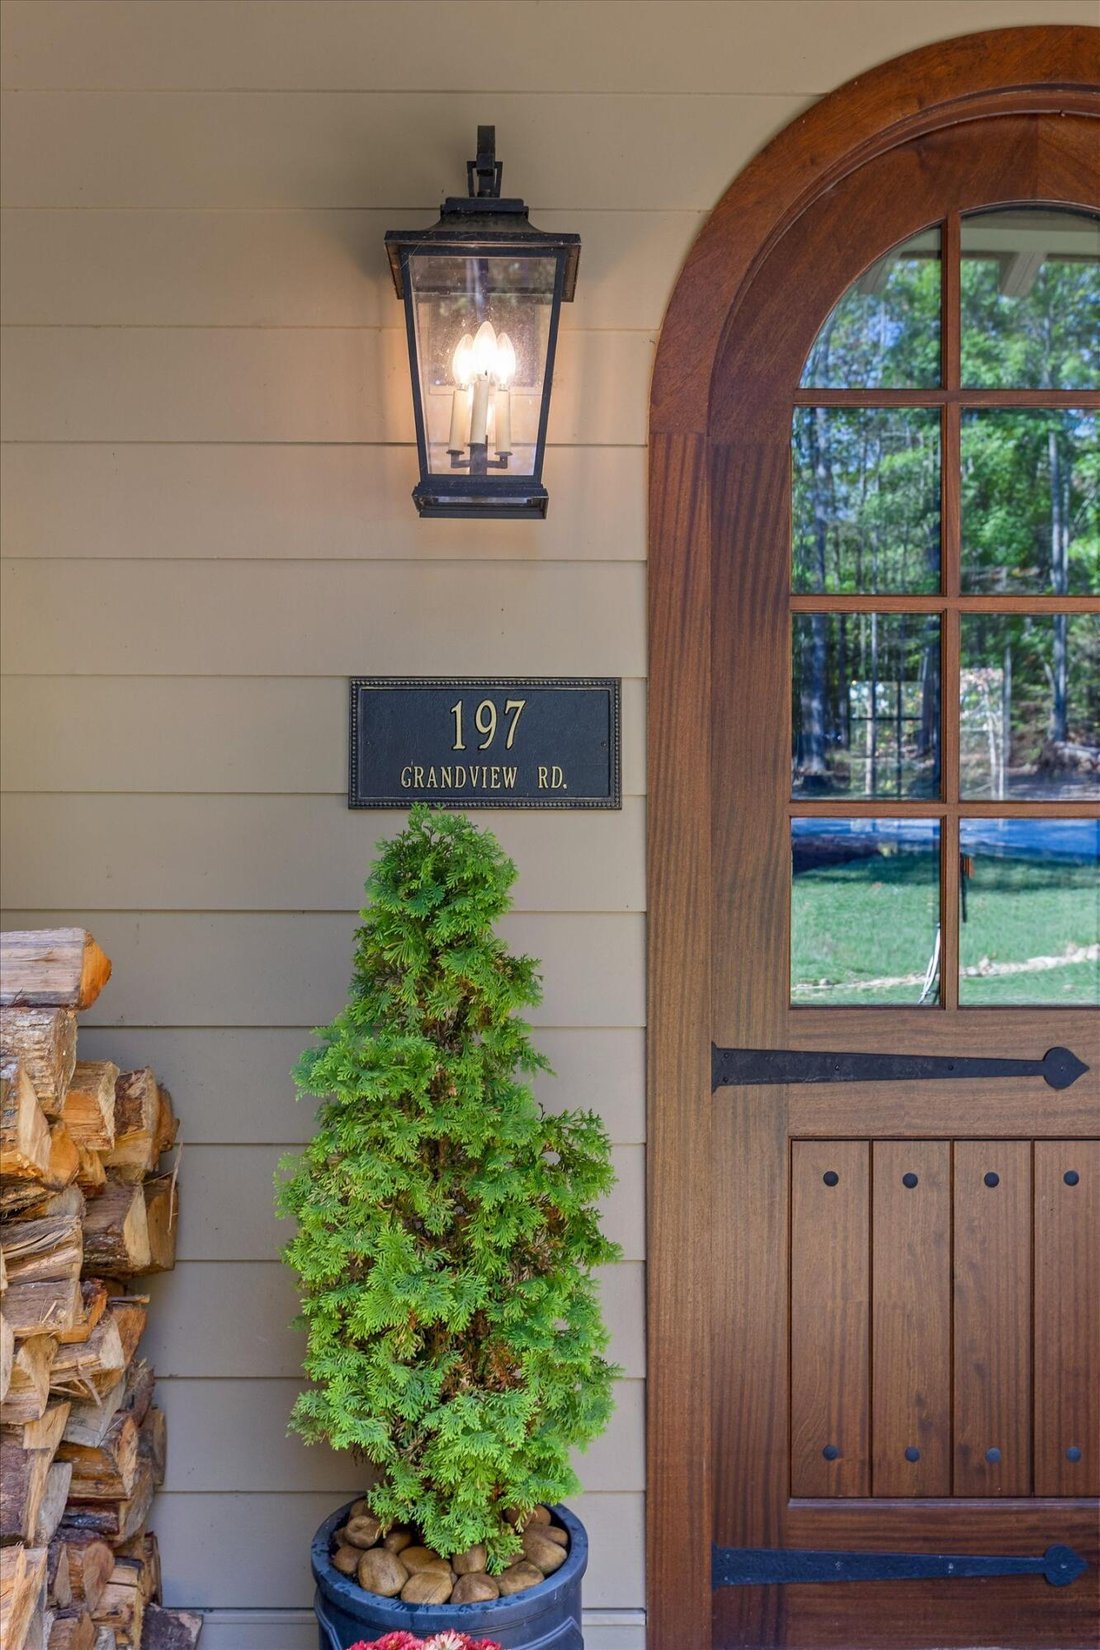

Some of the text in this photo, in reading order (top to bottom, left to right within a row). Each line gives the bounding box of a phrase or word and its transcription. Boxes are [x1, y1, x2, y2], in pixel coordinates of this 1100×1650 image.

[451, 700, 526, 750] 197
[401, 766, 568, 789] GRANDVIEW RD.
